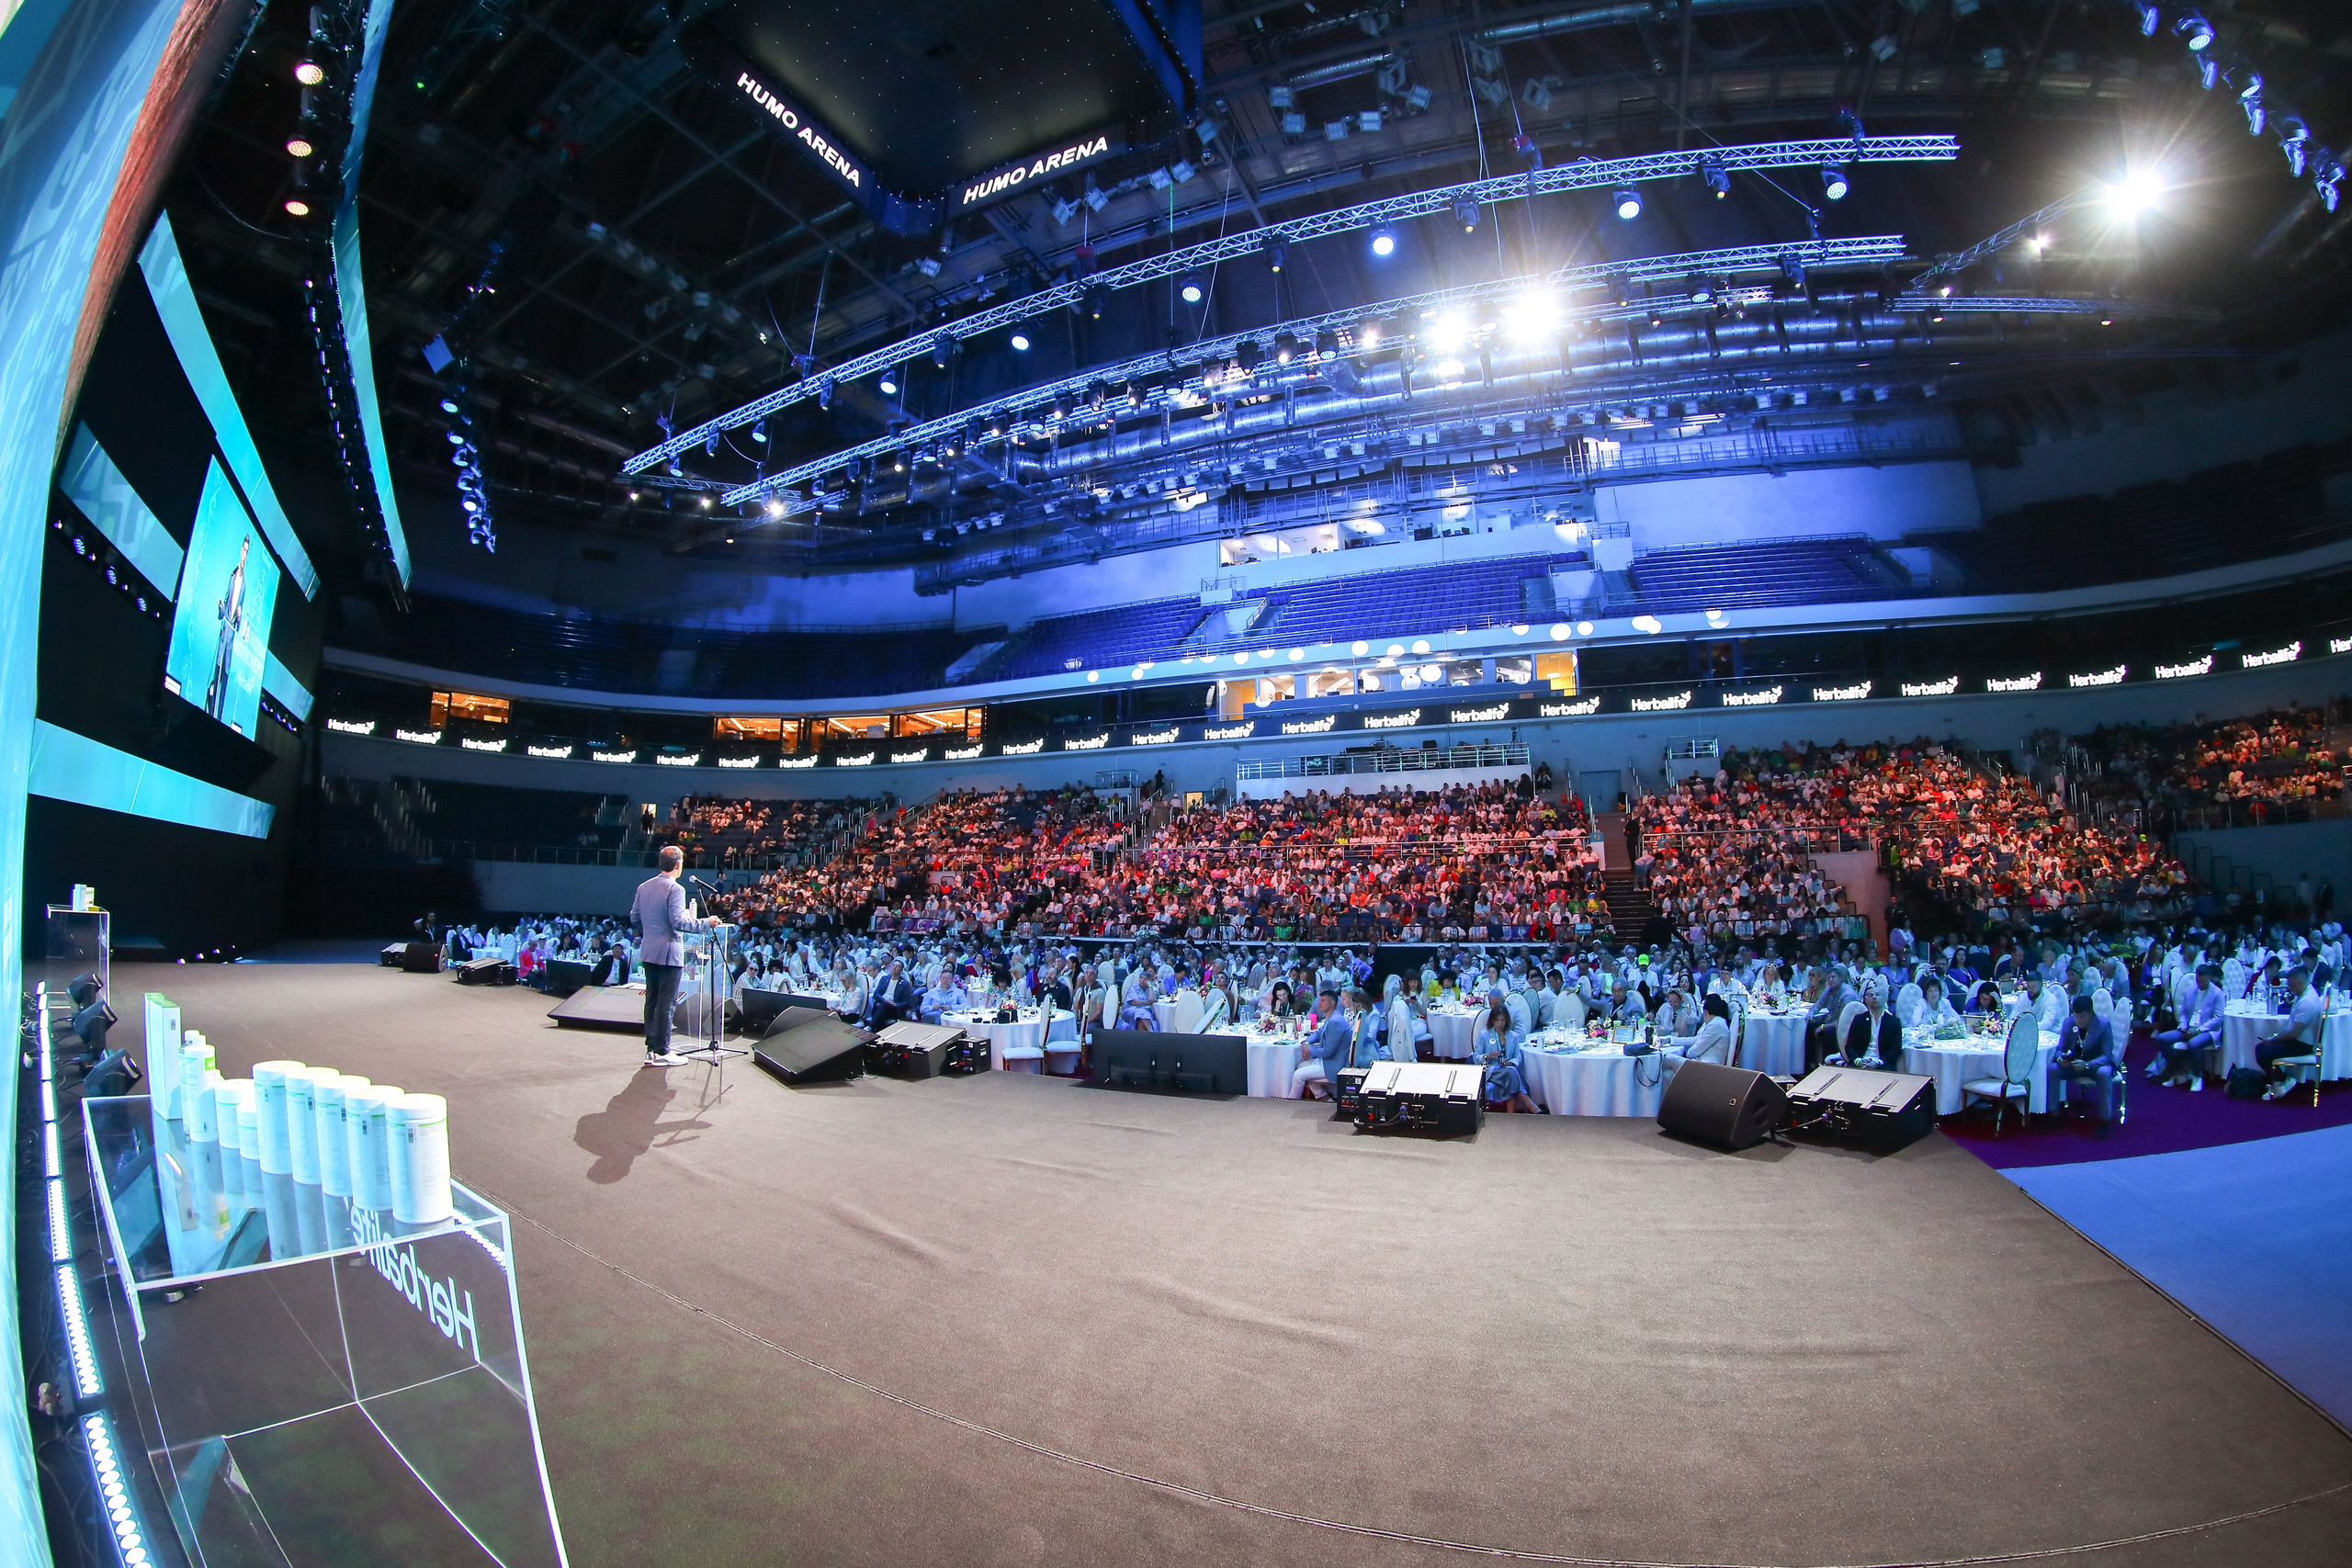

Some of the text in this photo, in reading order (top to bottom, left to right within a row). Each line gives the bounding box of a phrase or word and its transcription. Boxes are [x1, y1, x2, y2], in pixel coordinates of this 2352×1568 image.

[737, 72, 860, 187] HUMO ARENA
[963, 136, 1108, 204] HUMO ARENA
[2243, 642, 2299, 668] Herbalife
[2070, 666, 2124, 687] Herbalife
[2155, 656, 2211, 679] Herbalife
[1902, 677, 1957, 696] Herbalife
[1987, 672, 2040, 692] Herbalife
[1723, 686, 1781, 706] Herbalife
[1814, 682, 1870, 702] Herbalife
[1541, 697, 1599, 717] Herbalife
[1632, 692, 1690, 712] Herbalife
[1365, 710, 1419, 729] Herbalife
[1452, 704, 1508, 723] Herbalife
[328, 718, 374, 736] Herbalife
[1204, 722, 1253, 741] Herbalife
[1283, 716, 1334, 735] Herbalife
[397, 728, 441, 745] Herbalife
[462, 738, 506, 752] Herbalife
[1066, 734, 1107, 750] Herbalife
[1133, 728, 1178, 746] Herbalife
[528, 745, 571, 759] Herbalife
[891, 750, 926, 763] Herbalife
[945, 745, 982, 760] Herbalife
[1003, 739, 1042, 755] Herbalife
[594, 750, 636, 764] Herbalife
[657, 753, 698, 767] Herbalife
[718, 755, 759, 769] Herbalife
[780, 754, 817, 769] Herbalife
[837, 753, 873, 767] Herbalife
